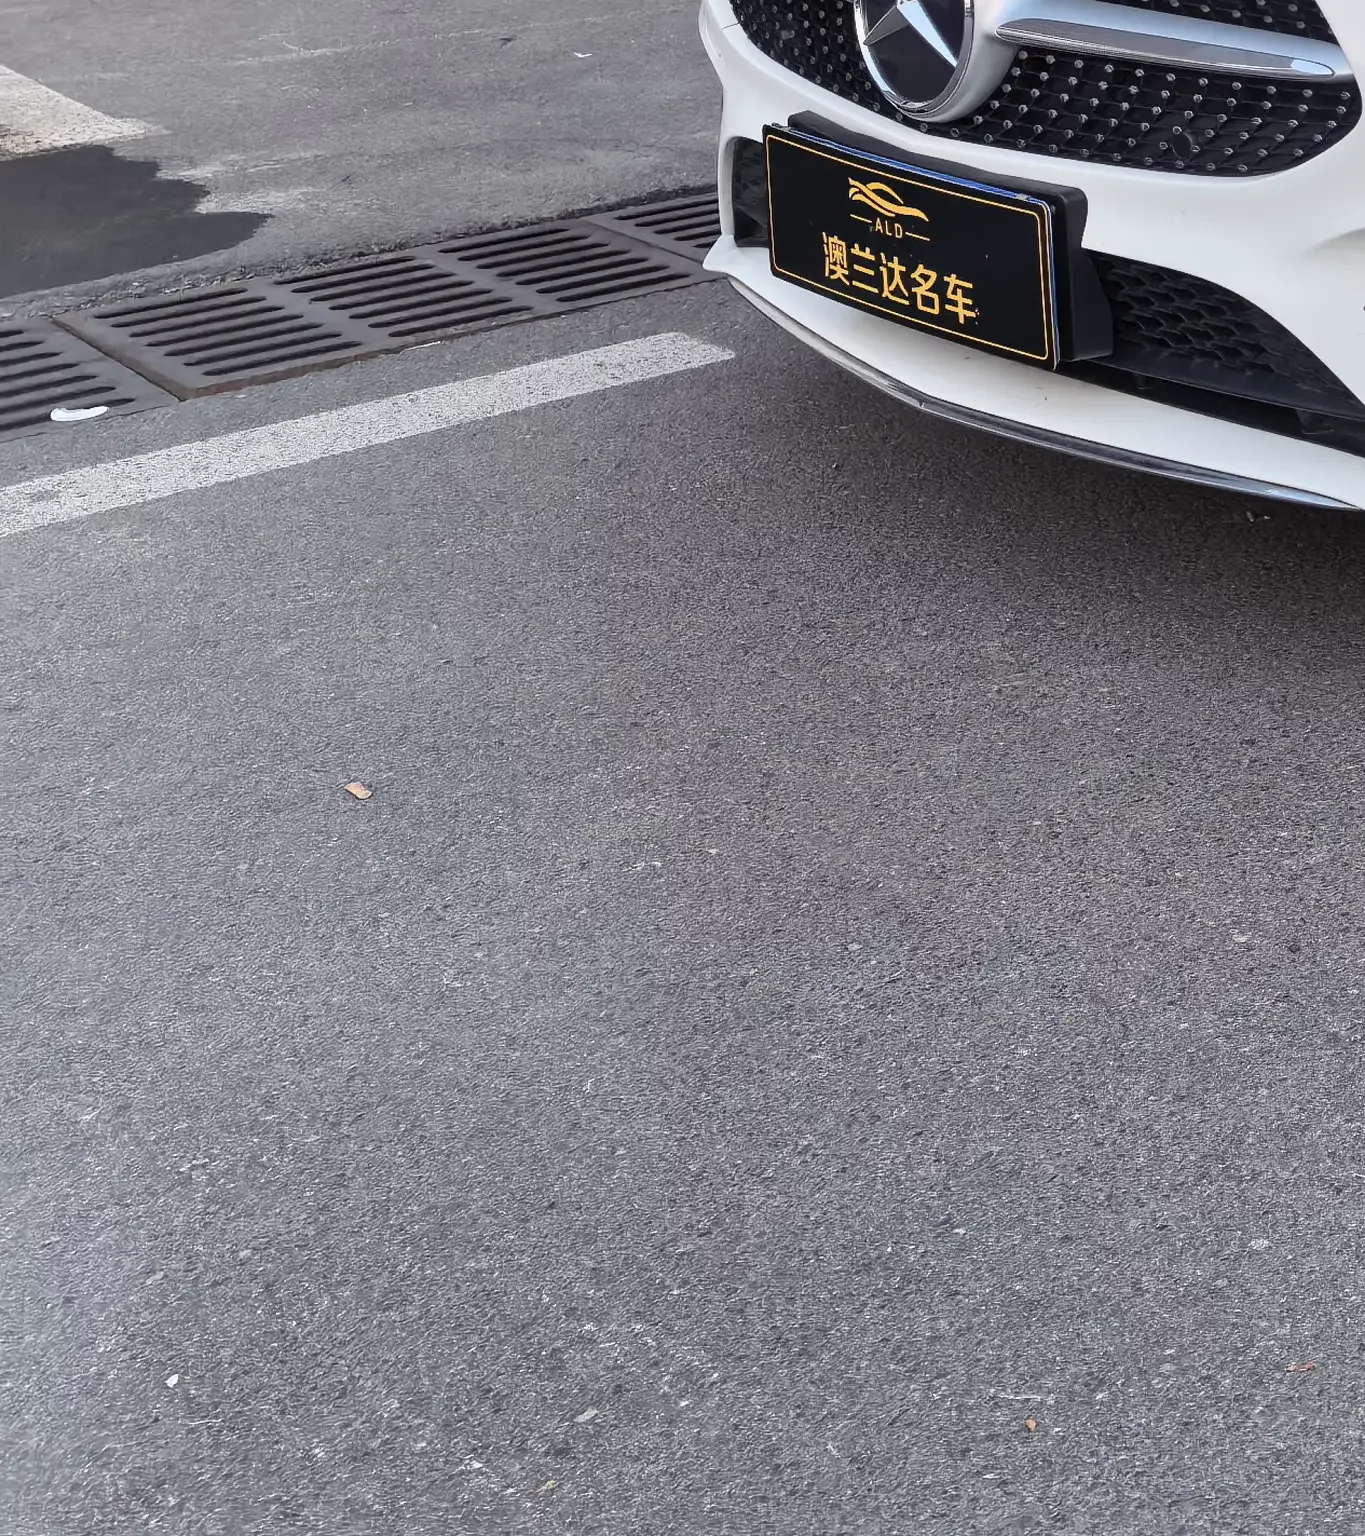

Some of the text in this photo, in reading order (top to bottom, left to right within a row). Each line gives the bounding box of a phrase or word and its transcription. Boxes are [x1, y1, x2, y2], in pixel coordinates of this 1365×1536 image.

[874, 219, 903, 239] ALD
[822, 231, 977, 325] 澳兰达名车
